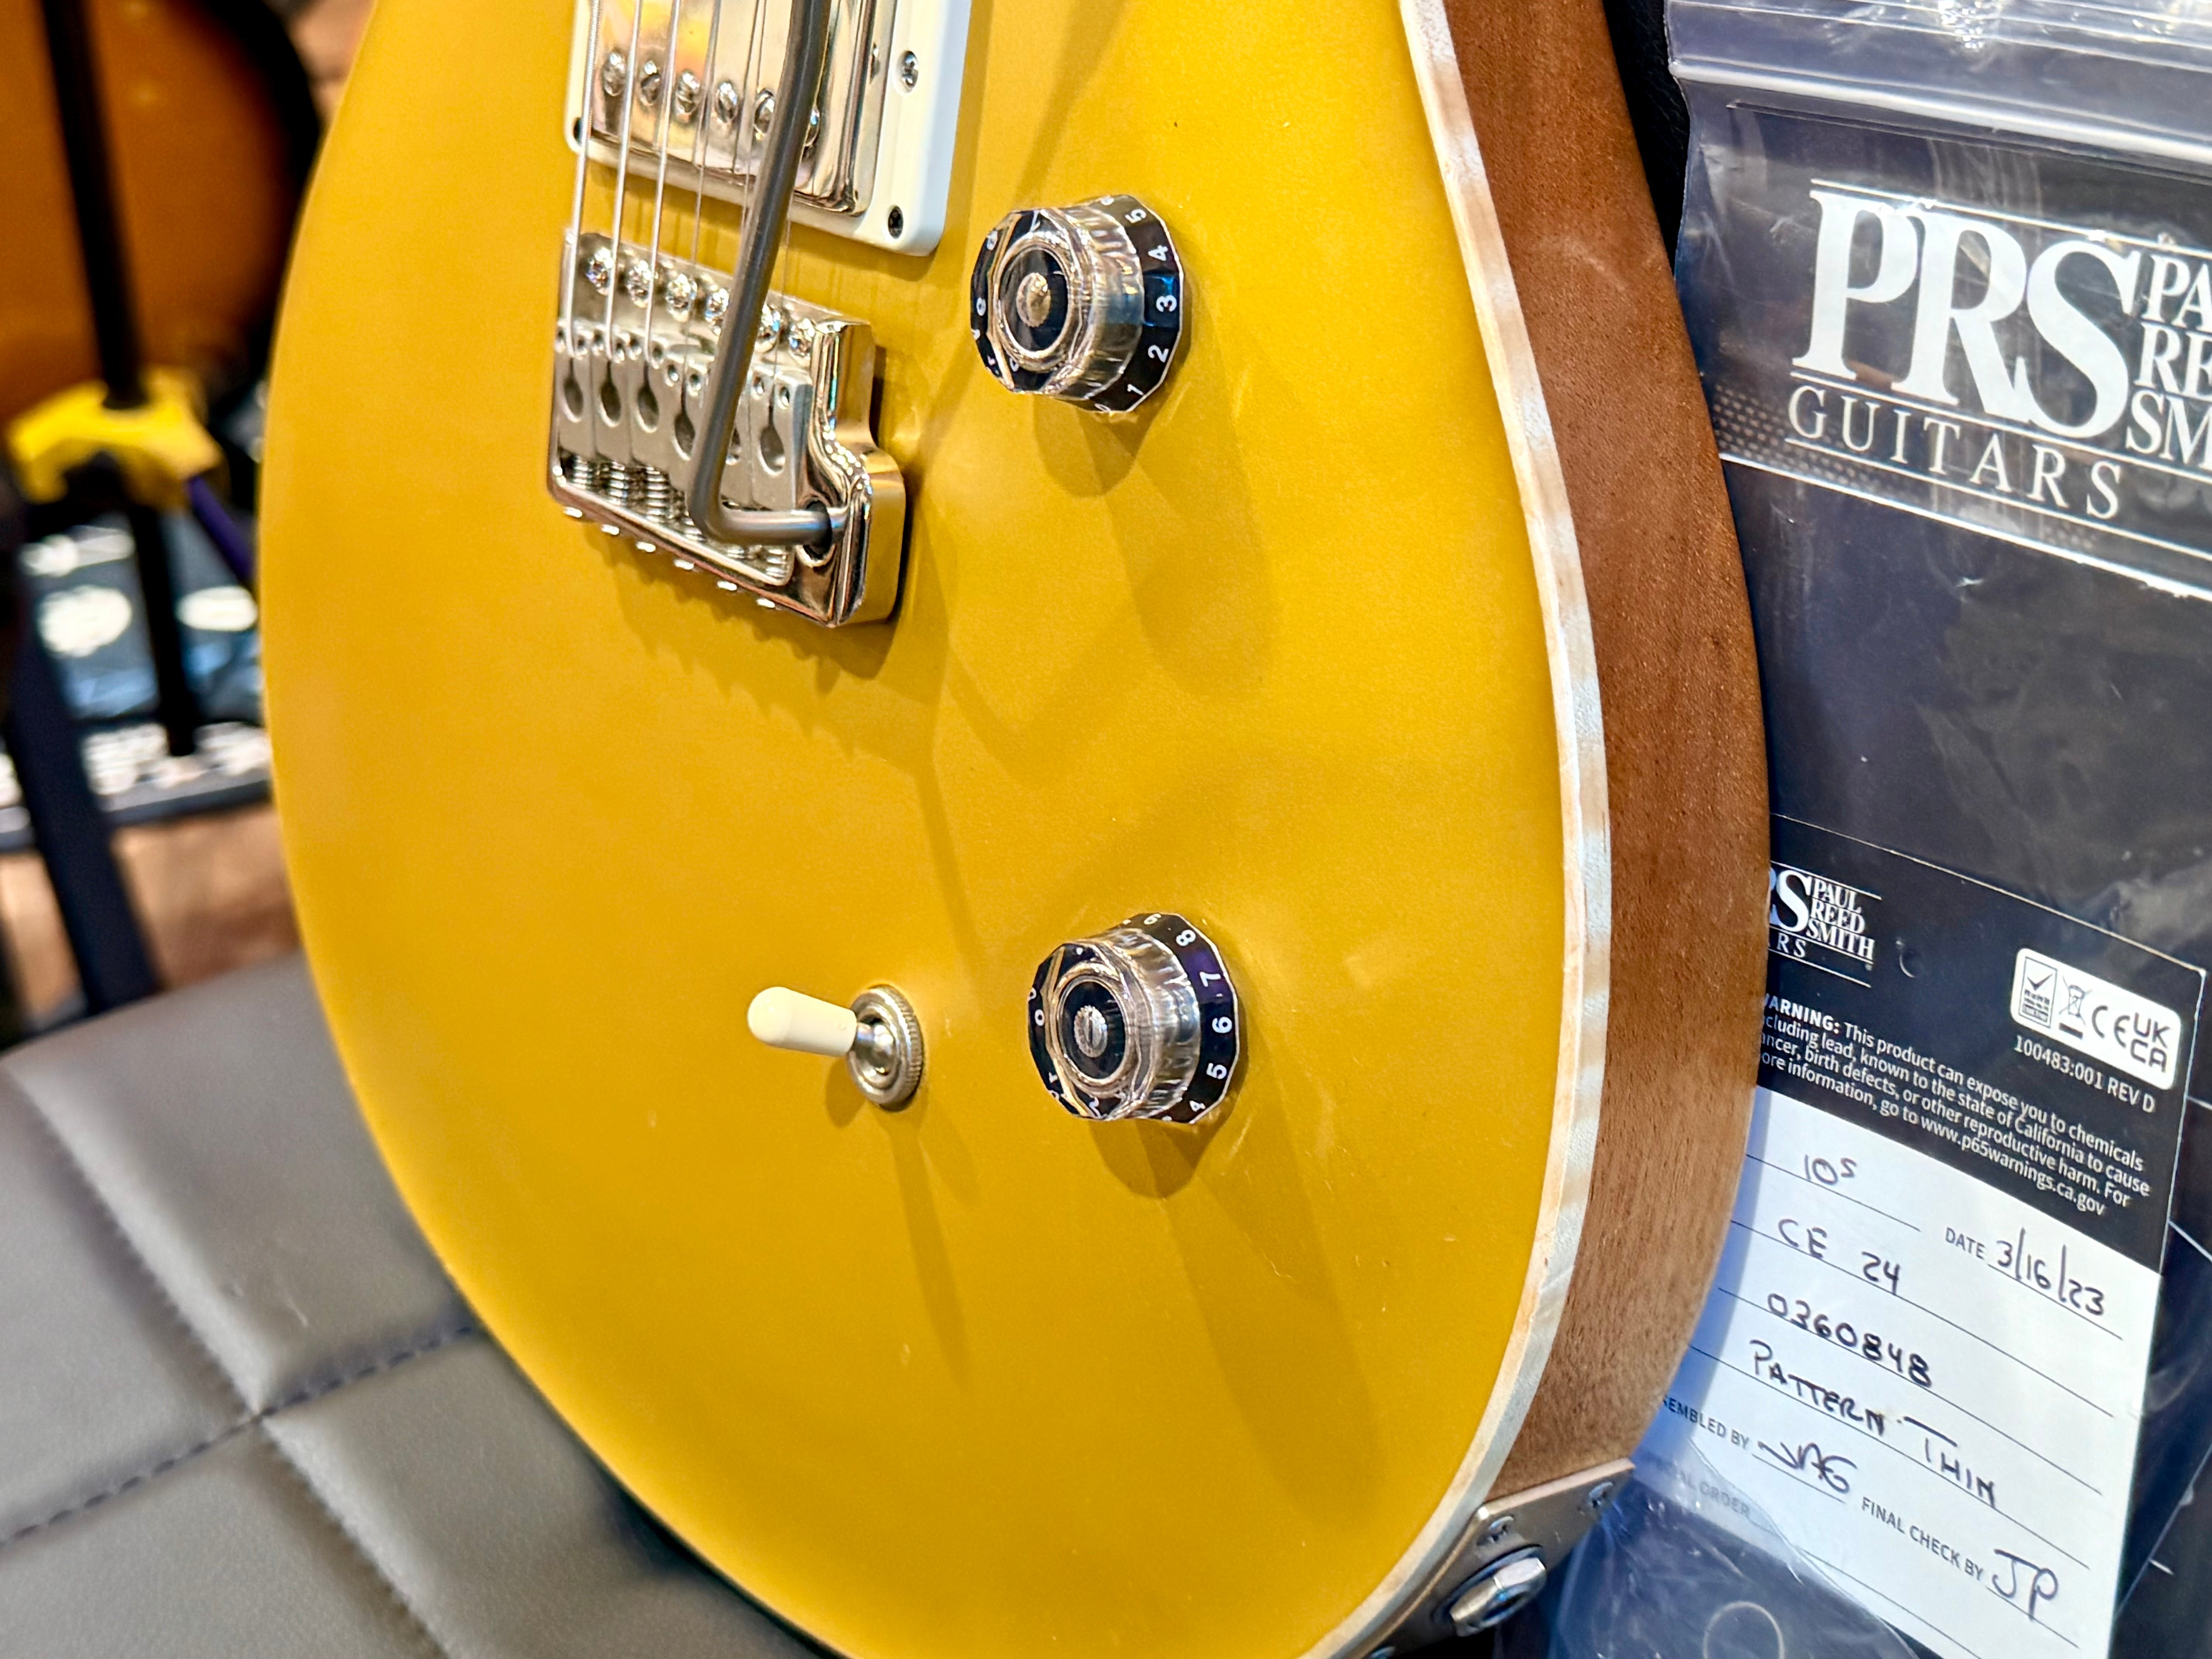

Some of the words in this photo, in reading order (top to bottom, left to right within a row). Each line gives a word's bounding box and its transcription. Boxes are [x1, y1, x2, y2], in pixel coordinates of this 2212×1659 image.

[1125, 209, 1146, 223] 5
[1148, 245, 1168, 261] 4
[1156, 295, 1177, 312] 3
[1792, 190, 2141, 438] PRS
[1148, 345, 1169, 362] 2
[1127, 384, 1144, 395] 1
[1790, 386, 2121, 519] GUITARS
[1812, 878, 1862, 913] PAUL
[1810, 897, 1865, 933] REED
[1176, 929, 1196, 946] 8
[1806, 919, 1875, 960] SMITH
[1200, 972, 1221, 987] 7
[1212, 1017, 1232, 1033] 6
[2134, 1012, 2170, 1048] UK
[1206, 1063, 1227, 1079] 5
[2130, 1039, 2167, 1073] CA
[1765, 1015, 1819, 1049] cluding
[1822, 1032, 1856, 1063] lead,
[1861, 1047, 1910, 1082] known
[1913, 1070, 1928, 1089] to
[1932, 1079, 1956, 1101] the
[1958, 1092, 1995, 1120] state
[1997, 1110, 2014, 1128] of
[2014, 1116, 2084, 1163] California
[2088, 1152, 2103, 1173] to
[2106, 1164, 2151, 1197] cause
[1844, 1022, 1874, 1047] This
[1876, 1039, 1936, 1073] product
[1937, 1064, 1963, 1085] can
[1966, 1076, 2018, 1110] expose
[2020, 1101, 2047, 1124] you
[2051, 1112, 2066, 1133] to
[2069, 1123, 2145, 1171] chemicals
[2107, 1077, 2141, 1105] REV
[2142, 1094, 2155, 1113] D
[1762, 1052, 1784, 1070] ore
[1788, 1058, 1877, 1110] information,
[1879, 1099, 1899, 1116] go
[1903, 1106, 1918, 1124] to
[1921, 1115, 2106, 1216] www.p65warnings.ca.gov
[1805, 1045, 1839, 1073] birth
[1843, 1062, 1899, 1100] defects,
[1903, 1089, 1921, 1104] or
[1922, 1099, 1962, 1123] other
[1964, 1115, 2056, 1170] reproductive
[2059, 1158, 2100, 1194] harm.
[2105, 1182, 2132, 1207] For
[1779, 1219, 1827, 1259] CE
[1862, 1251, 1900, 1295] 24
[1946, 1227, 1986, 1260] DATE
[1997, 1227, 2104, 1316] 3/16/23
[1767, 1293, 1932, 1388] 0360848
[1750, 1339, 1885, 1436] PATTERN
[1664, 1396, 1726, 1438] EMBLED
[1731, 1429, 1750, 1450] BY
[1862, 1496, 1905, 1534] FINAL
[1910, 1525, 1962, 1570] CHECK
[1965, 1558, 1984, 1582] BY
[1992, 1549, 2059, 1621] JP
